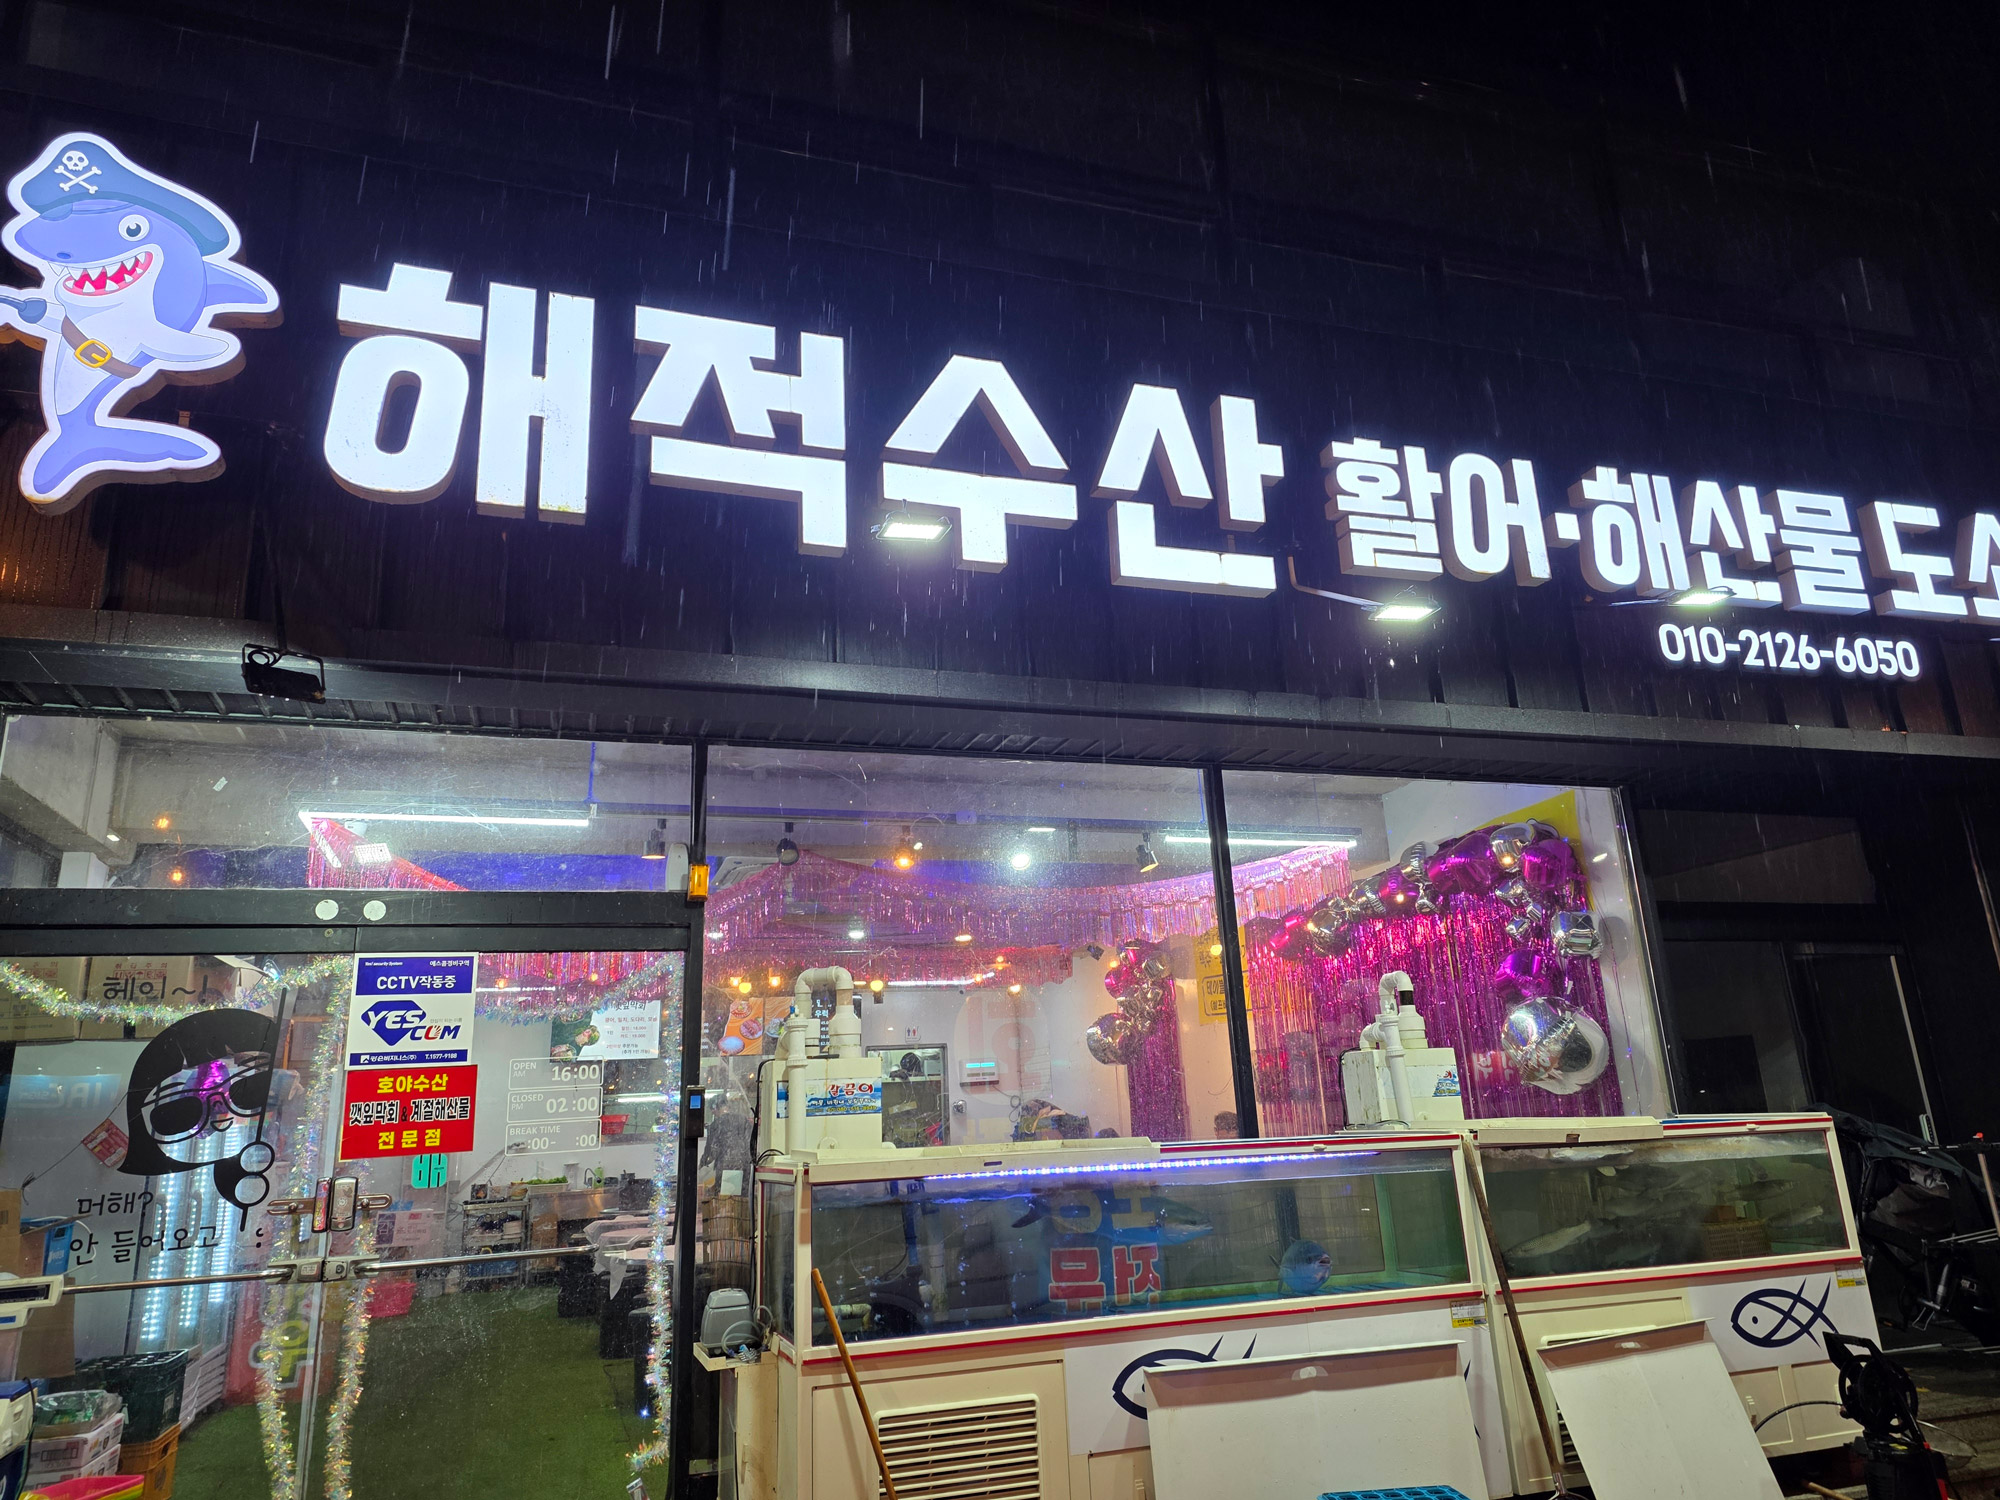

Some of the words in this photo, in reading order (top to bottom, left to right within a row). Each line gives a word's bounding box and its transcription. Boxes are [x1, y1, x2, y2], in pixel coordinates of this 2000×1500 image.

[323, 262, 1285, 595] 해적수산
[1657, 622, 1921, 679] 010-2126-6050
[376, 975, 457, 990] CCTV작동중
[513, 1062, 537, 1070] OPEN
[551, 1064, 600, 1082] 16:00
[377, 1073, 449, 1094] 호야수산
[511, 1093, 544, 1103] CLOSED
[349, 1100, 400, 1126] 깻잎막회
[410, 1096, 471, 1122] 계절해산물
[509, 1126, 538, 1136] BREAK
[539, 1125, 561, 1134] TIME
[69, 1233, 99, 1266] 안
[111, 1225, 219, 1264] 들어오고
